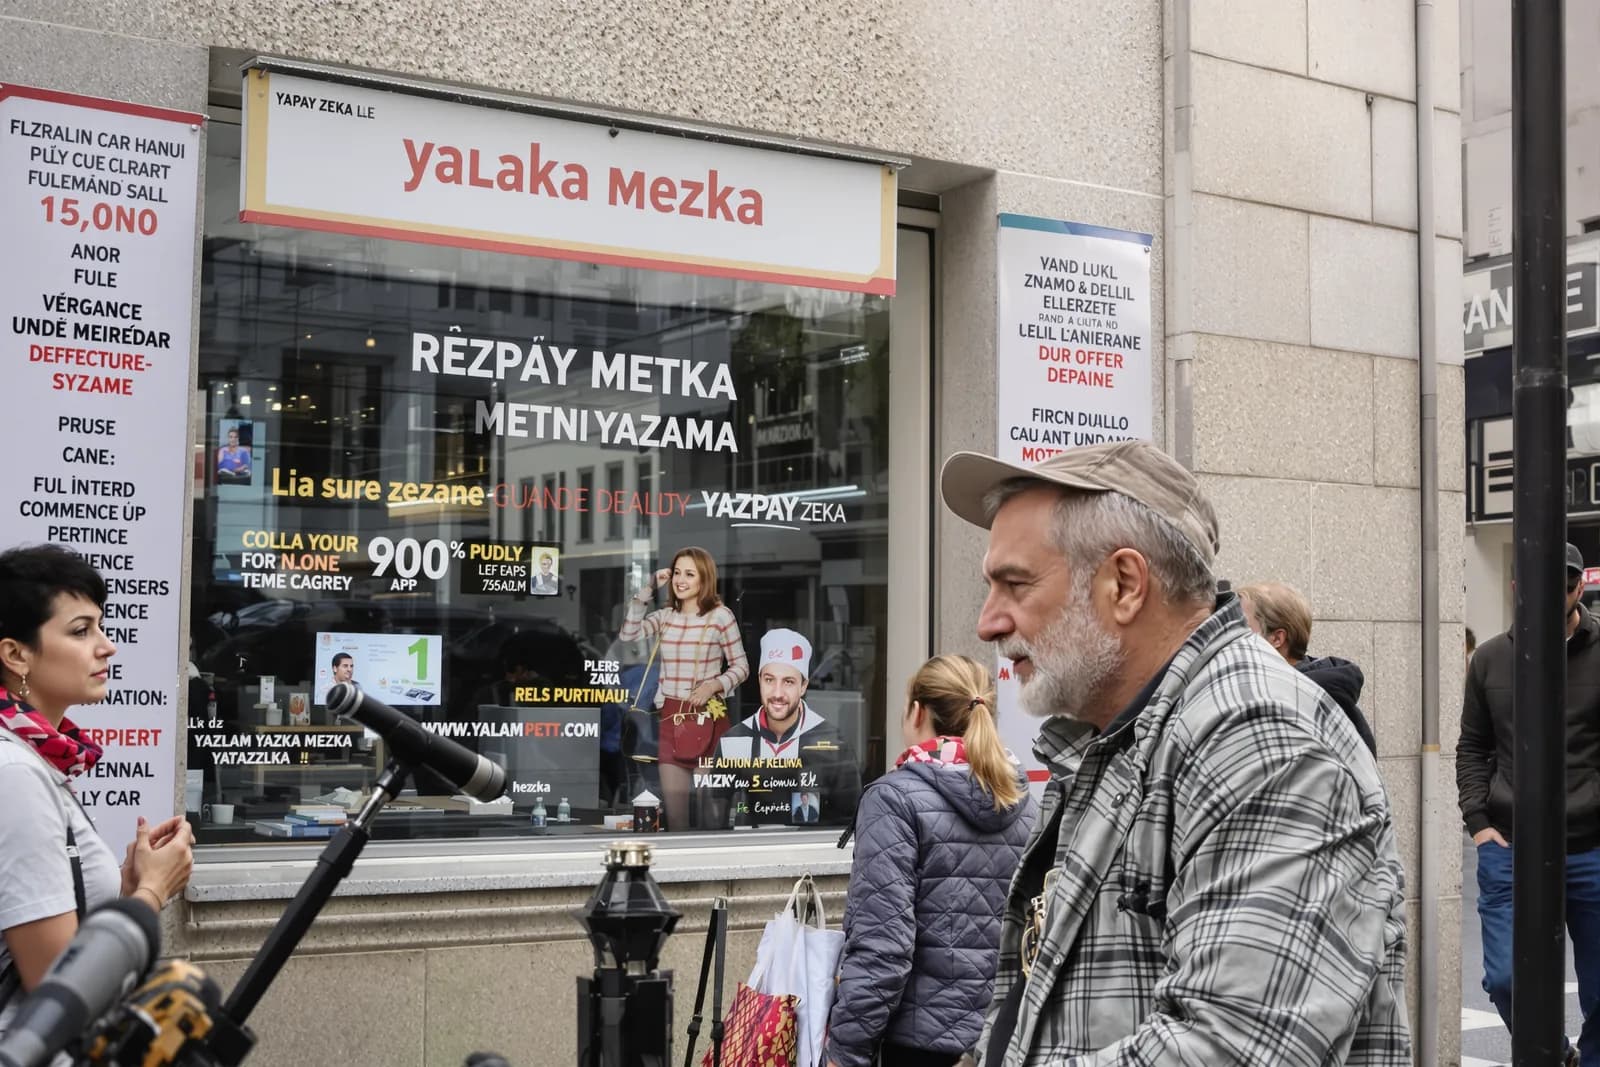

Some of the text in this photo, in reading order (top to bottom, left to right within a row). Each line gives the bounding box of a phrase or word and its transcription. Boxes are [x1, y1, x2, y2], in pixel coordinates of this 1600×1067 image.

[276, 92, 316, 109] YAPAY
[319, 99, 353, 116] ZEKA
[10, 119, 185, 159] FLZRALIN CAR HANUI
[72, 152, 105, 171] CUE
[109, 158, 171, 180] CLRART
[127, 183, 168, 203] SALL
[71, 243, 121, 263] ANOR
[74, 268, 117, 288] FULE
[1083, 261, 1118, 280] LUKL
[1024, 274, 1075, 293] ZNAMO
[1078, 281, 1088, 294] &
[1043, 295, 1117, 316] ELLERZETE
[29, 344, 152, 371] DEFFECTURE-
[1039, 345, 1123, 369] DUR OFFER
[52, 373, 133, 396] SYZAME
[591, 351, 737, 401] METKA
[1048, 366, 1114, 388] DEPAINE
[58, 416, 116, 436] PRUSE
[475, 399, 588, 442] METNI
[594, 410, 738, 453] YAZAMA
[1032, 408, 1074, 425] FIRCN
[1010, 426, 1038, 443] CAU
[1042, 430, 1070, 446] ANT
[62, 446, 115, 466] CANE:
[34, 476, 67, 494] FUL
[272, 467, 314, 497] Lia
[321, 476, 381, 501] sure
[387, 481, 485, 506] zezane
[493, 483, 589, 512] GUANDE
[701, 490, 799, 522] YAZPAY
[800, 501, 847, 523] ZEKA
[20, 500, 119, 521] COMMENCE
[48, 525, 128, 545] PERTINCE
[242, 530, 358, 553] COLLA YOUR
[241, 552, 275, 569] FOR
[470, 543, 524, 561] PUDLY
[478, 563, 526, 577] LEF EAPS
[241, 572, 353, 591] TEME CAGREY
[391, 578, 417, 591] APP
[408, 637, 429, 681] 1
[584, 660, 620, 672] PLERS
[589, 673, 621, 685] ZAKA
[515, 687, 629, 703] RELS PURTINAU!
[195, 735, 352, 747] YAZLAM YAZKA MEZKA
[752, 775, 760, 788] 5
[106, 790, 140, 806] CAR
